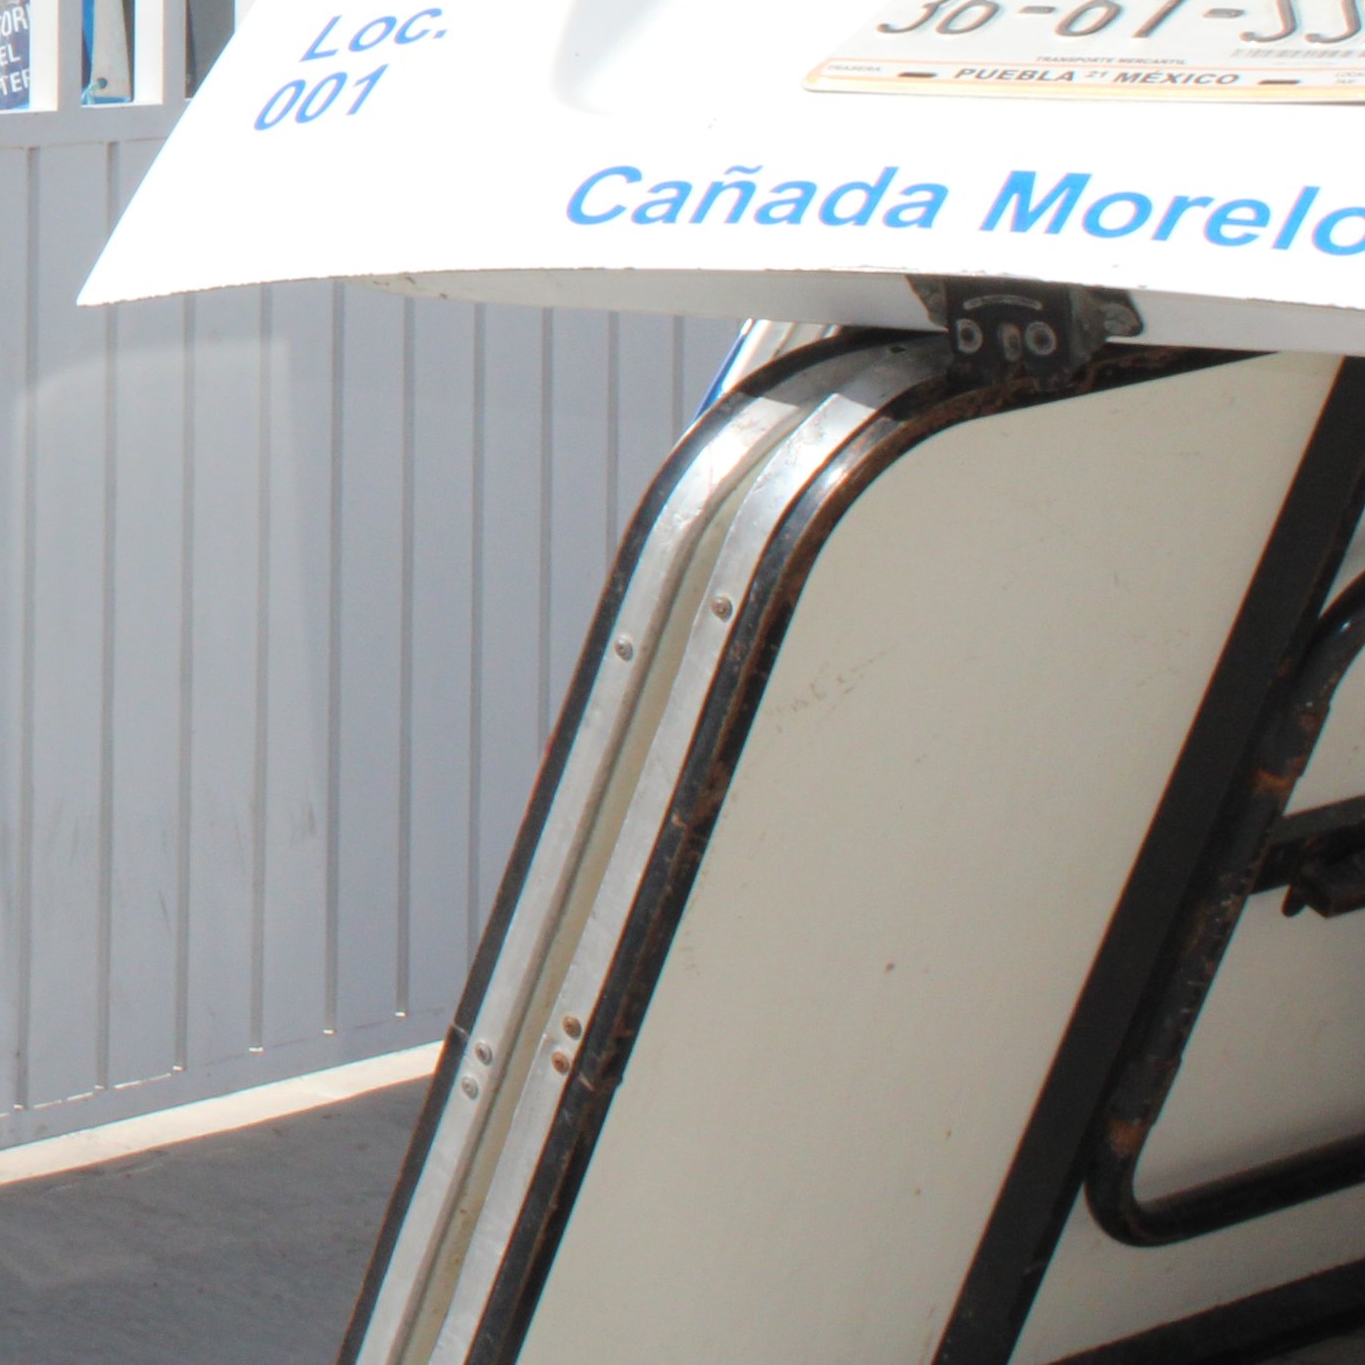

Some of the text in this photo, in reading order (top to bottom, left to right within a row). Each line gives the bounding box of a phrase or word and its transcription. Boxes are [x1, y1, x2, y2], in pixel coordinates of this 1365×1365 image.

[254, 64, 389, 131] 001
[953, 67, 1075, 83] PUEBLA
[1113, 70, 1241, 85] MÉXICO
[567, 163, 1365, 258] Cañada Morelo
